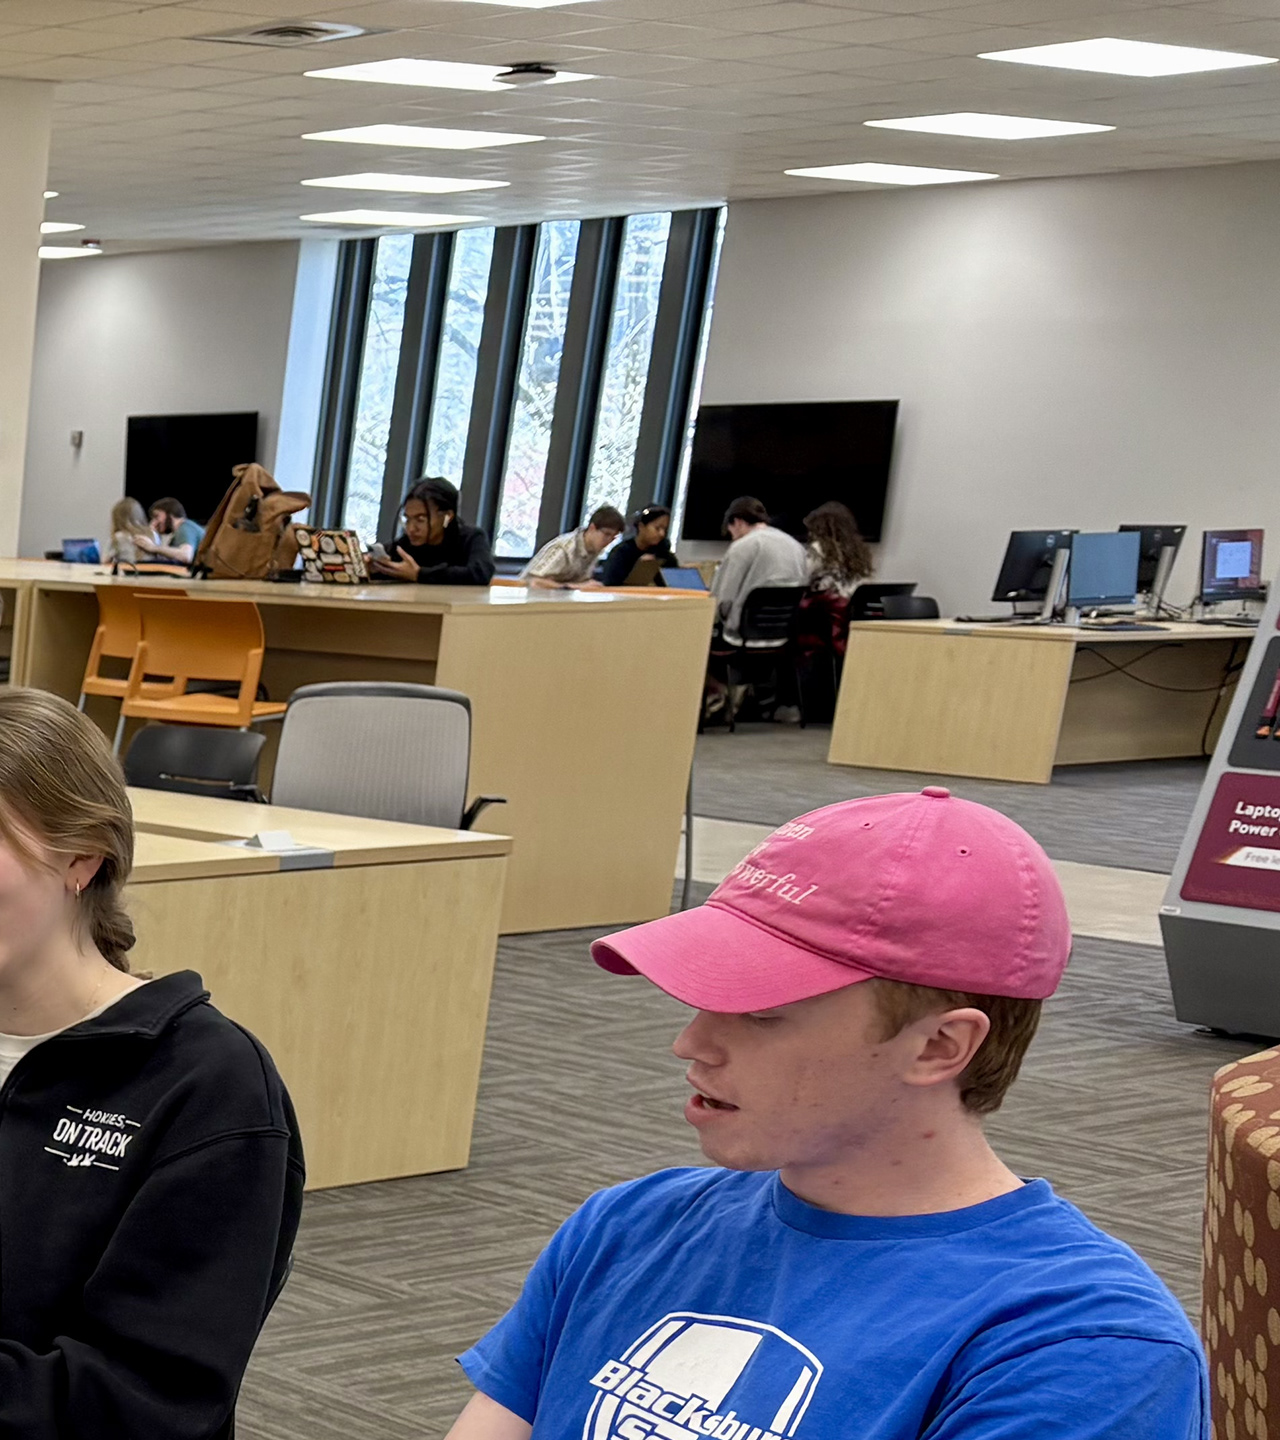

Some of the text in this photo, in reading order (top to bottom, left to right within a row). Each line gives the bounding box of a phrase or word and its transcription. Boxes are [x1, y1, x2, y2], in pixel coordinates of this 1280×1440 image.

[1235, 801, 1280, 822] Lapto
[1229, 819, 1279, 837] Power
[53, 1118, 133, 1158] ON TRACK
